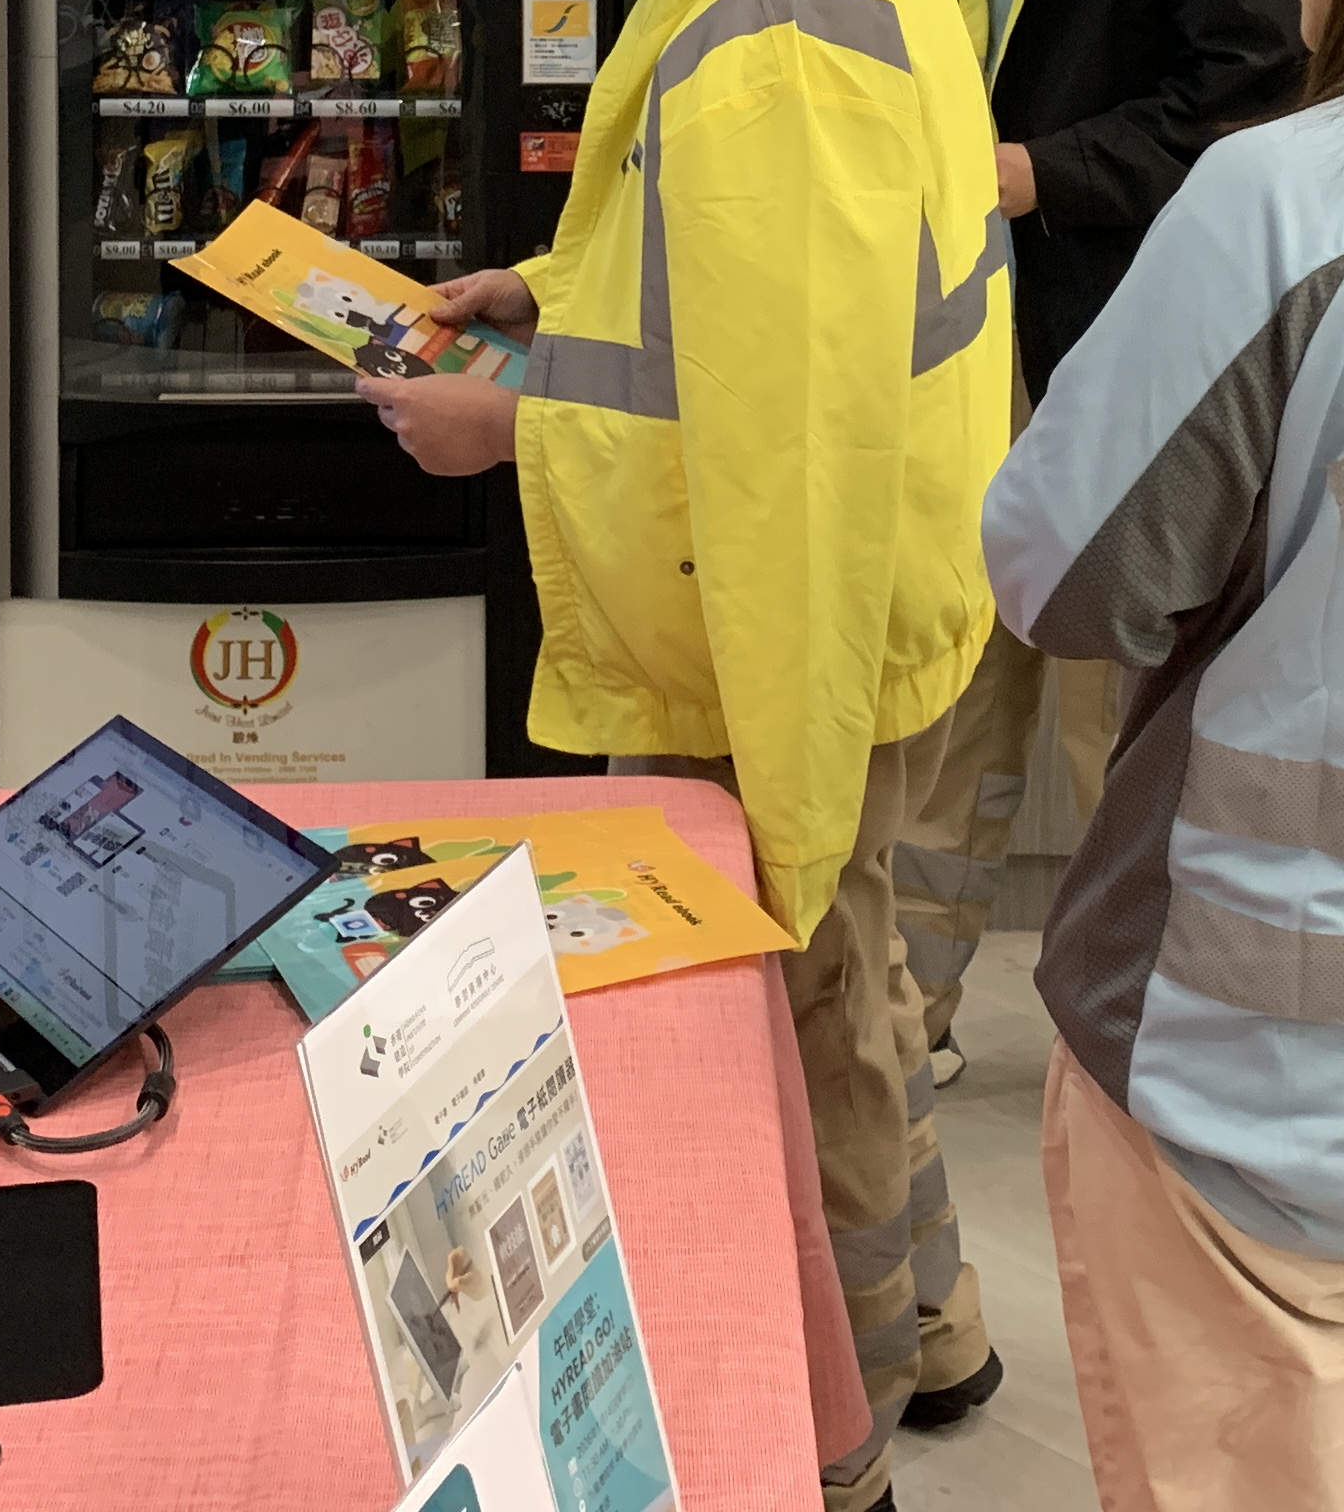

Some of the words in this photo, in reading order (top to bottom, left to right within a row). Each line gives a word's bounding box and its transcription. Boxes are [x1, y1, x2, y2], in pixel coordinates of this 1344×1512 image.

[123, 101, 166, 115] $4.20
[228, 101, 271, 115] $6.00
[335, 102, 377, 116] $8.60
[105, 245, 136, 256] $9.00
[213, 639, 276, 681] JH
[219, 752, 232, 764] In
[235, 752, 288, 767] Vending
[291, 751, 347, 764] Services
[436, 1150, 487, 1220] HYREAD
[551, 1338, 595, 1407] HYREAD
[594, 1309, 615, 1346] GO!
